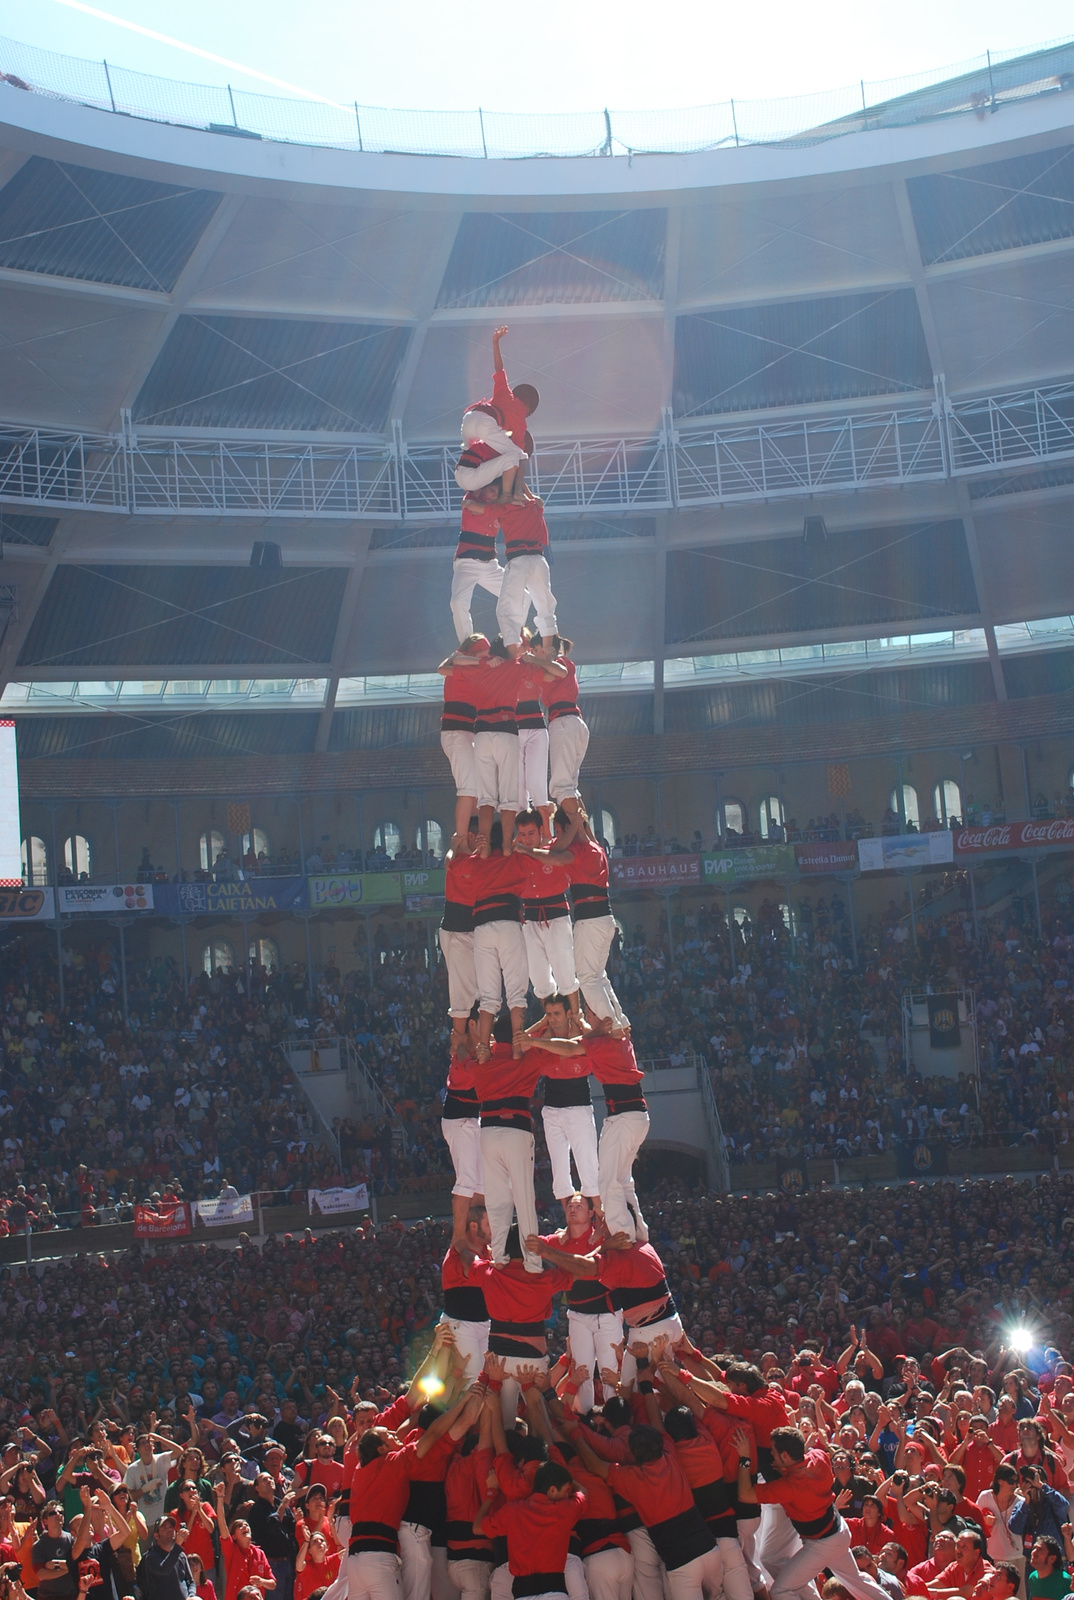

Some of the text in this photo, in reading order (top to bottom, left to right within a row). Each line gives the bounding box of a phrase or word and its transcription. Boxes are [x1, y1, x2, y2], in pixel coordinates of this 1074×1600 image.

[957, 826, 1011, 849] Coca-Cola
[1021, 819, 1074, 843] Coca-Cola
[797, 854, 855, 865] Estrella Damm
[627, 863, 698, 877] BAUHAUS
[207, 883, 252, 897] CAIXA
[208, 896, 277, 912] LAIETANA
[137, 1223, 187, 1232] de Barcelona
